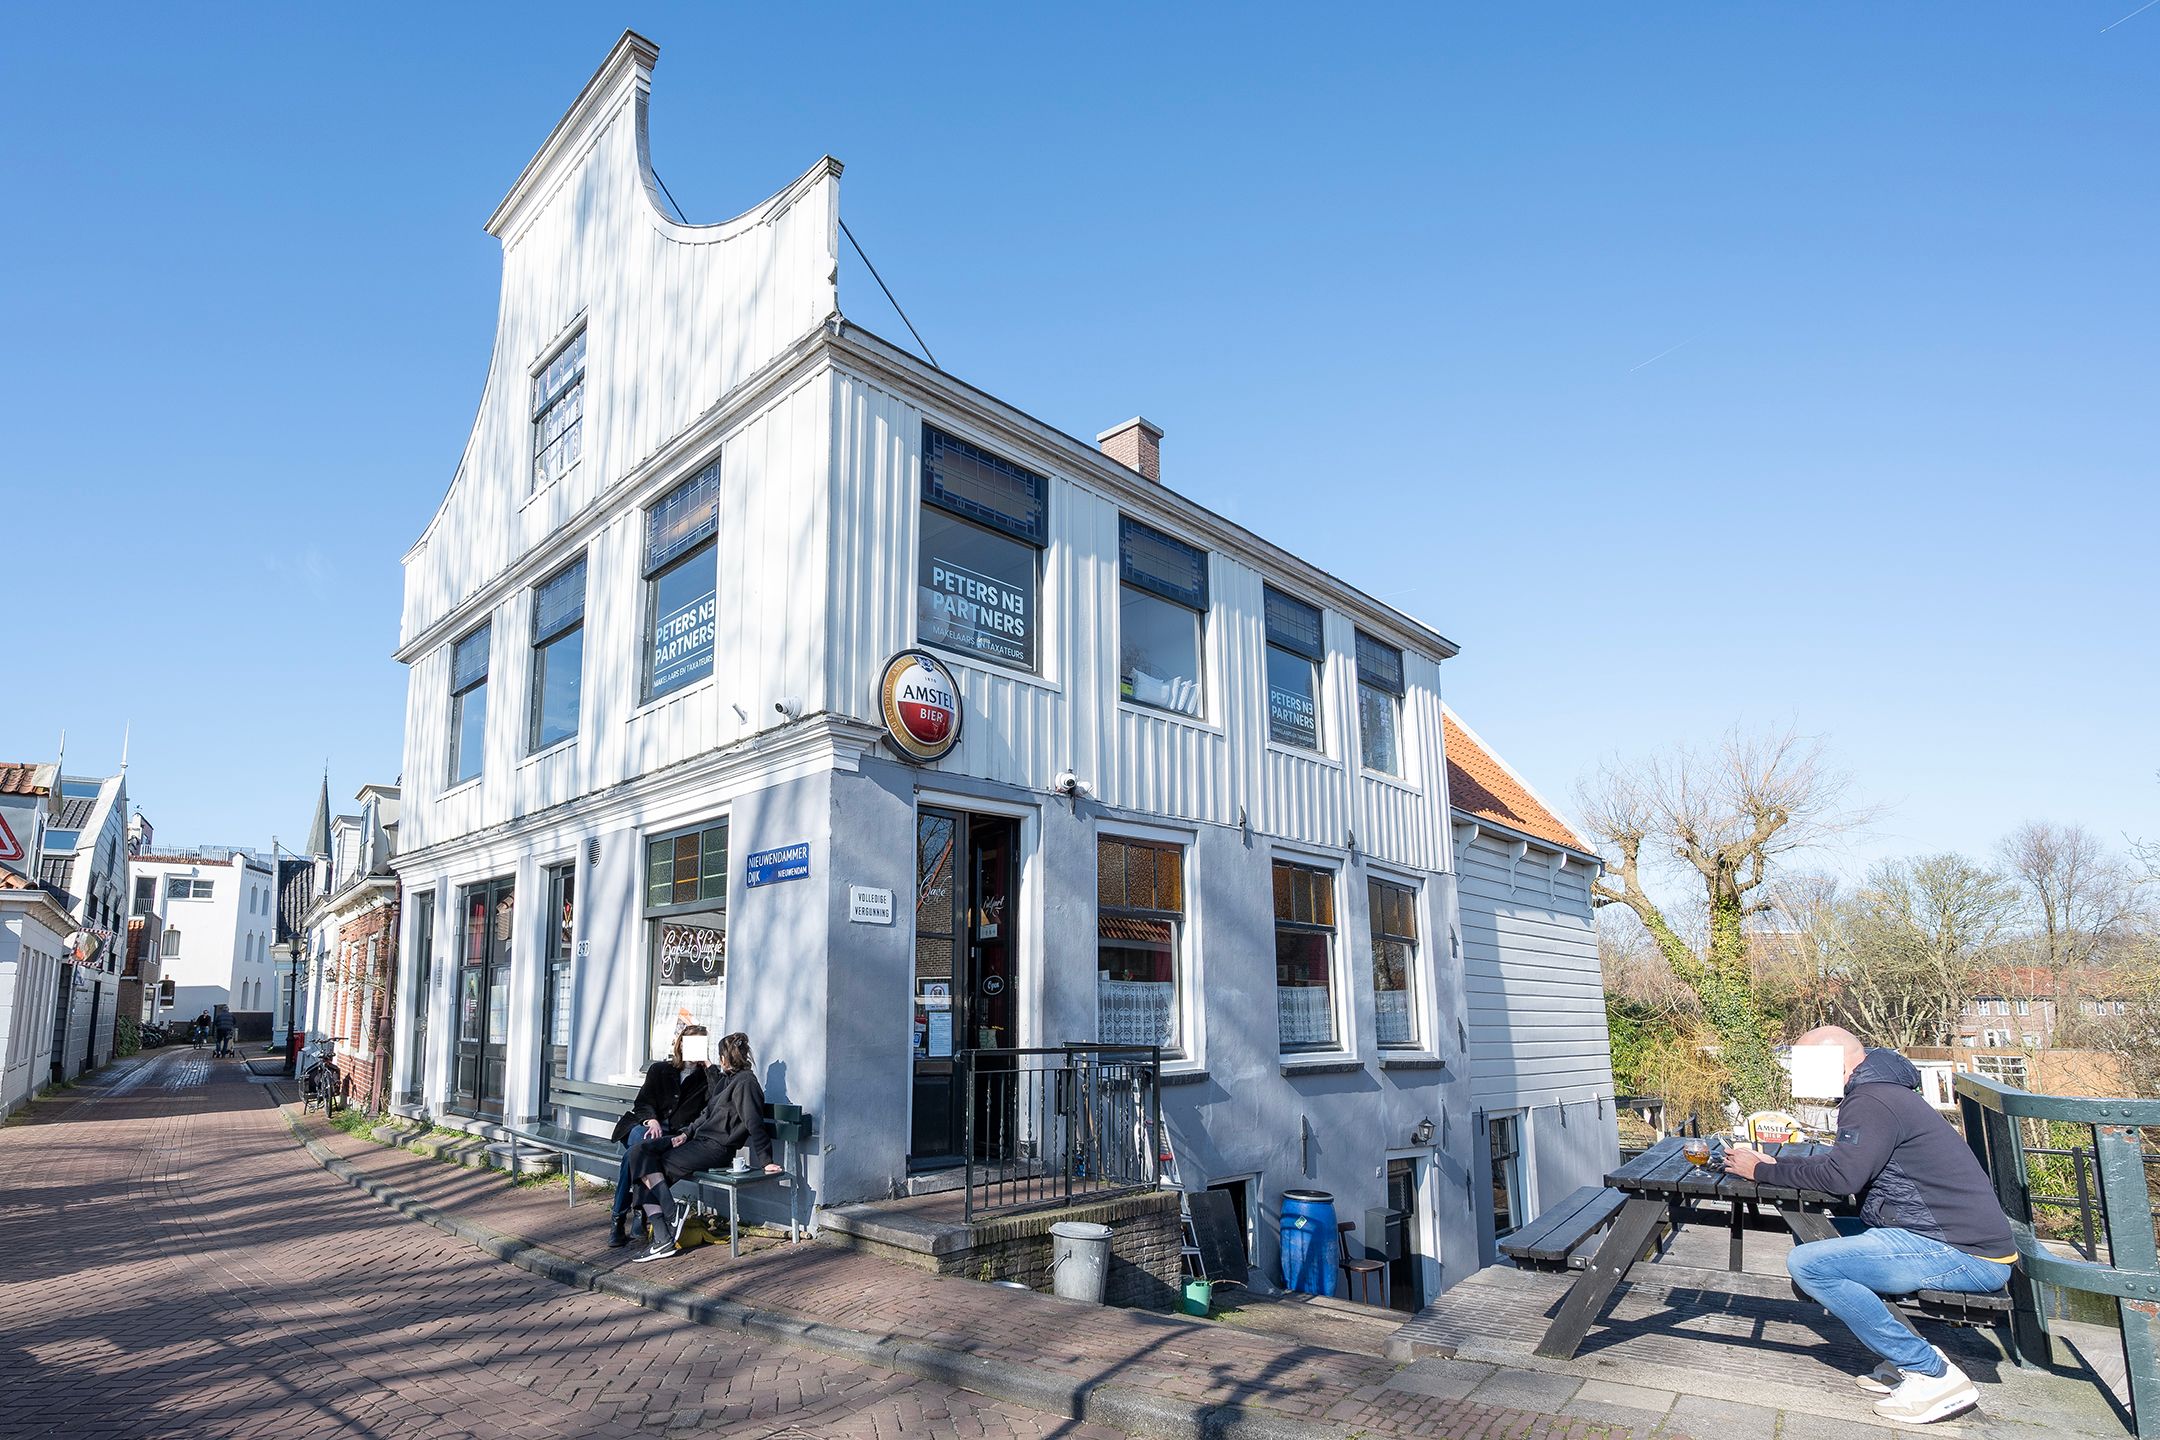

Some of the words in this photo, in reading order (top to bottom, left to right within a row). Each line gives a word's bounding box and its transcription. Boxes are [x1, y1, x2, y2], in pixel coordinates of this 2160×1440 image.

[933, 566, 998, 606] PETERS
[656, 608, 697, 645] PETERS
[933, 591, 1024, 637] PARTNERS
[655, 622, 715, 666] PARTNERS
[932, 625, 975, 645] MAKELAARS
[987, 641, 1024, 660] TAXATEURS
[884, 684, 895, 720] VOLGENS
[903, 685, 954, 710] AMSTEL
[1271, 690, 1301, 711] PETERS
[920, 708, 943, 723] BIER
[1271, 705, 1315, 730] PARTNERS
[748, 846, 807, 869] NIEUWENDAMMER
[777, 866, 808, 878] NIEUWENDAM
[857, 893, 887, 904] VOLLEDIGE
[854, 906, 890, 918] VERGUNNING
[578, 942, 588, 954] 297
